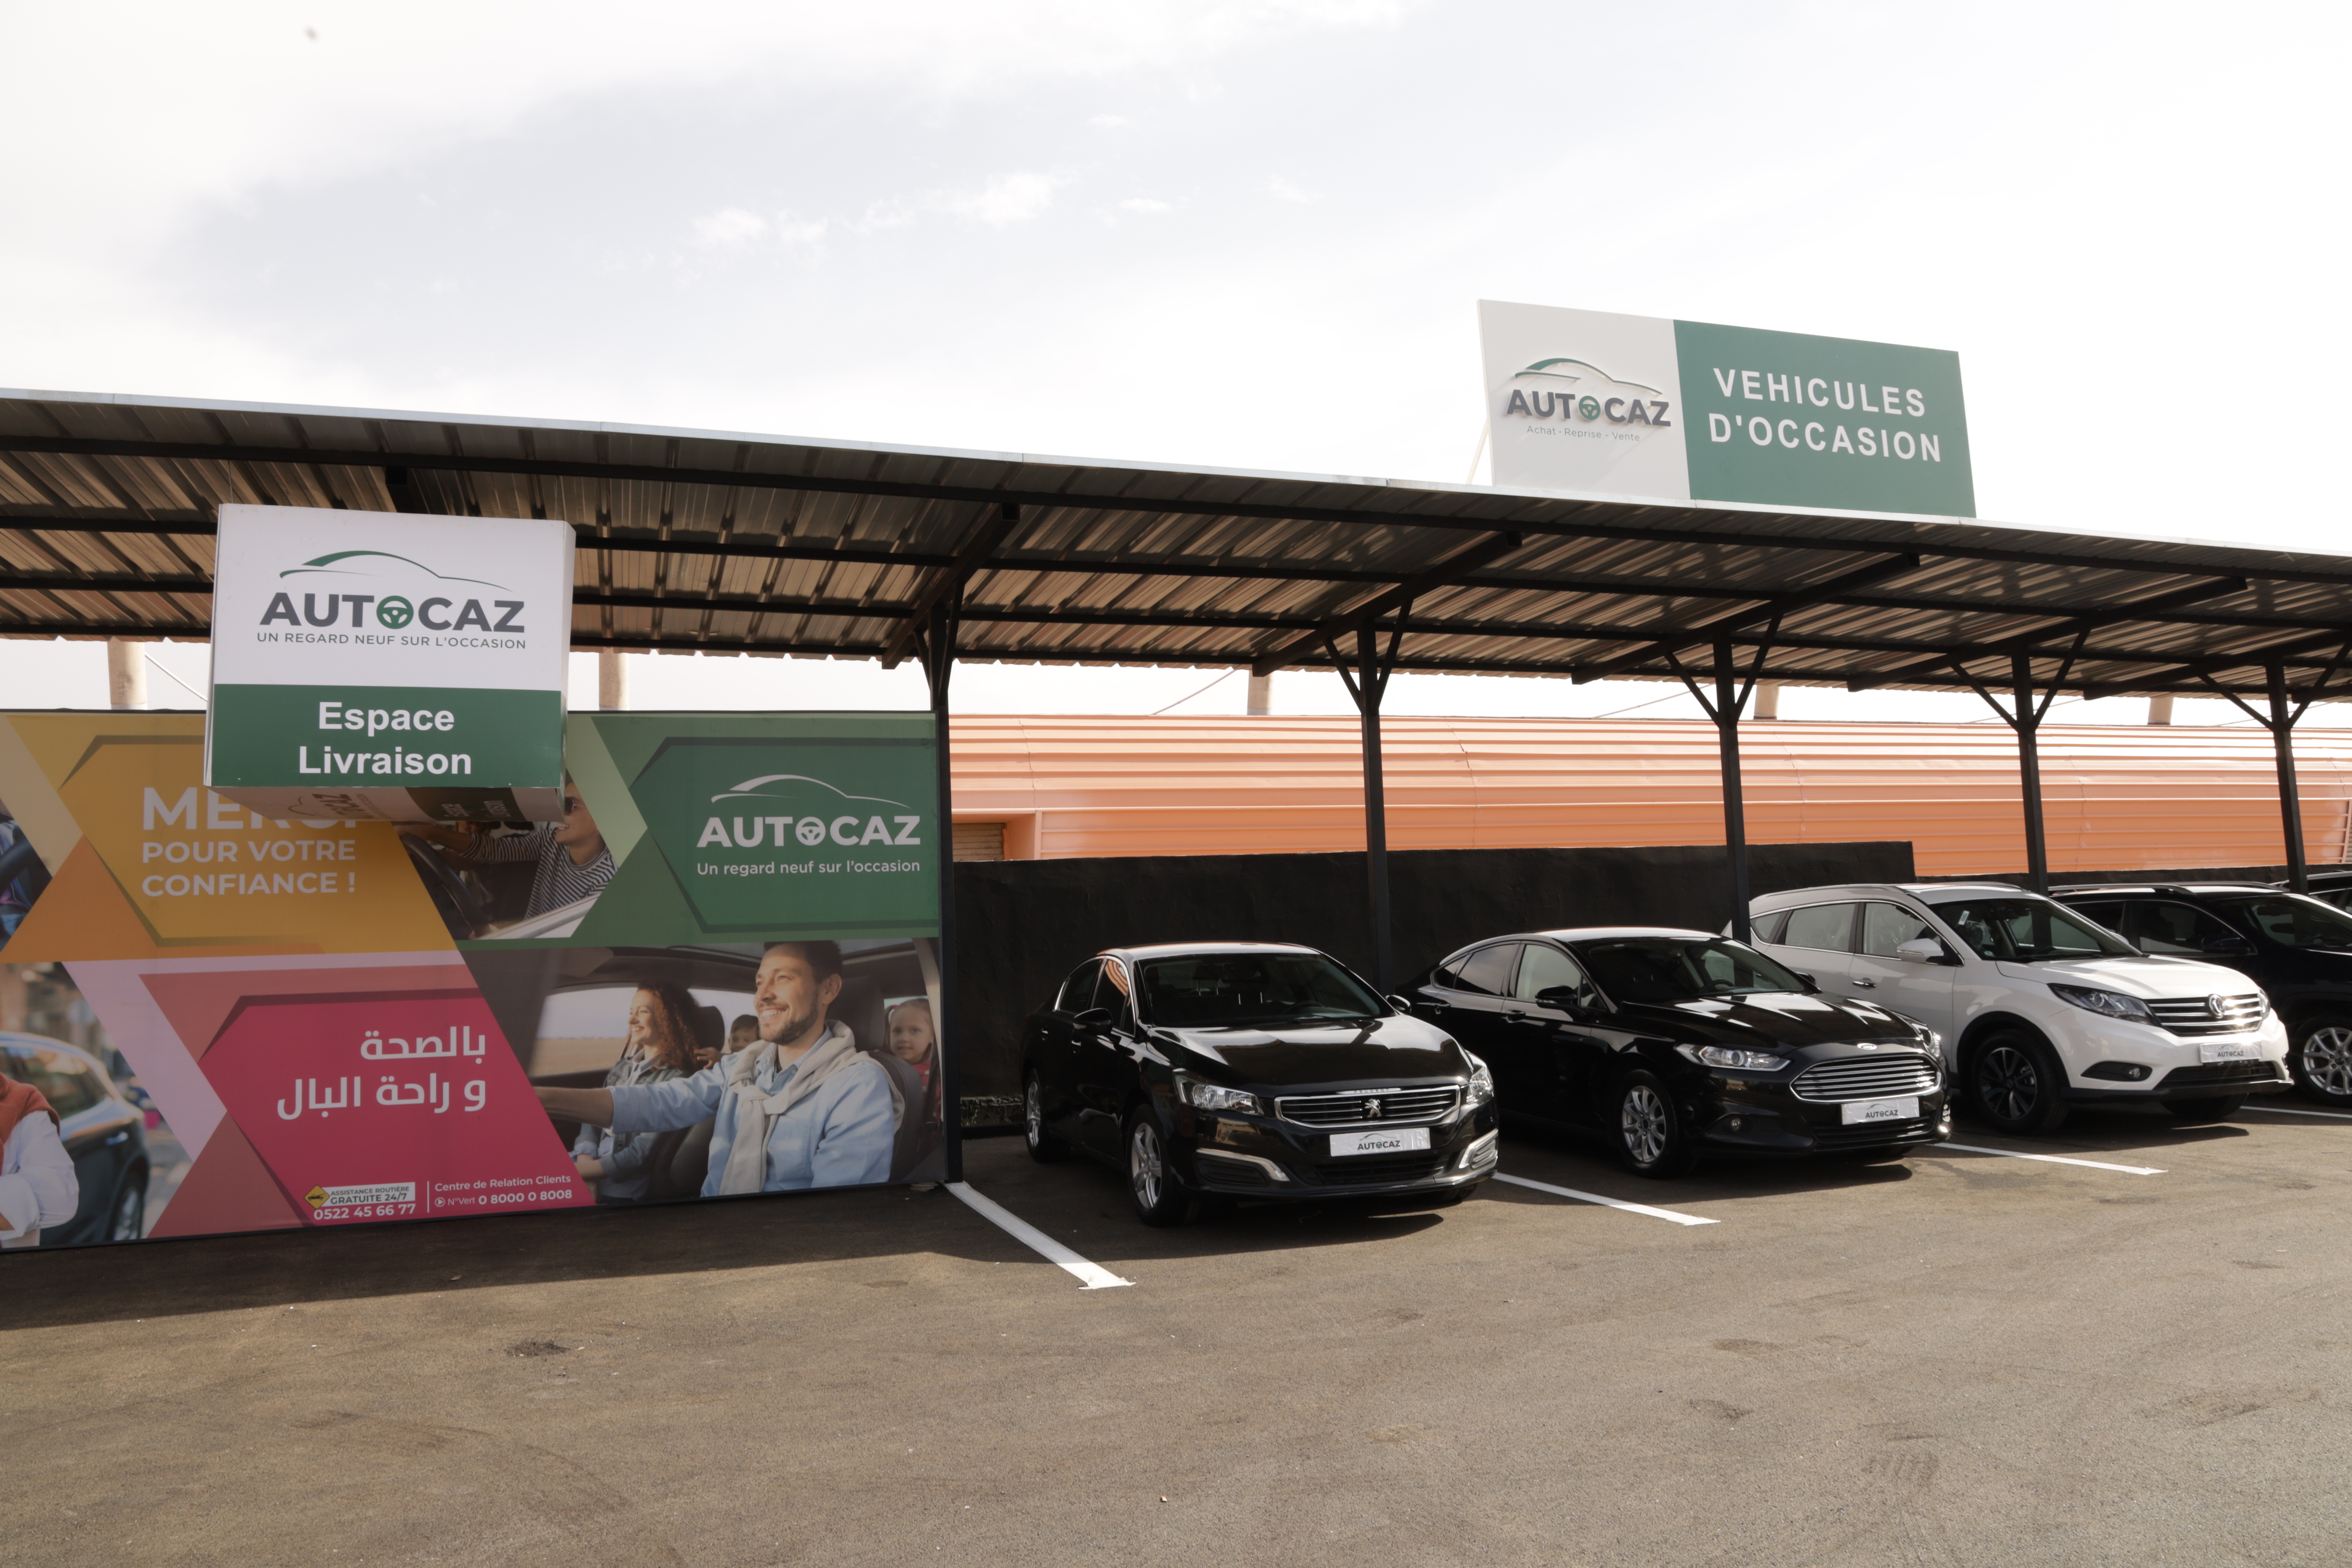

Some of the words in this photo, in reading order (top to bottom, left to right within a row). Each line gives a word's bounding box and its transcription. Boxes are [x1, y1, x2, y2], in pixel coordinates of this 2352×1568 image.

[1713, 368, 1925, 417] VEHICULES
[1506, 389, 1671, 427] AUTOCAZ
[1527, 426, 1556, 435] Achat
[1564, 428, 1602, 438] Reprise
[1612, 432, 1640, 441] Vente
[1709, 413, 1941, 462] D'OCCASION
[259, 592, 525, 633] AUTOCAZ
[257, 632, 279, 643] UN
[285, 633, 349, 644] REGARD
[355, 634, 395, 645] NEUF
[401, 635, 430, 646] SUR
[436, 637, 526, 649] L'OCCASION
[319, 701, 455, 737] Espace
[299, 746, 471, 775] Livraison
[696, 815, 921, 848] AUTOCAZ
[142, 841, 238, 864] POUR
[247, 840, 356, 862] VOTRE
[697, 863, 718, 875] Un
[724, 861, 775, 877] regard
[780, 861, 814, 873] neuf
[819, 861, 842, 873] sur
[847, 859, 920, 873] l'occasion
[142, 872, 338, 897] CONFIANCE
[360, 1026, 485, 1064] بالصحة
[277, 1076, 361, 1120] البال
[376, 1073, 449, 1114] راحة
[464, 1080, 486, 1112] و
[1865, 1110, 1898, 1118] AUTOCAZ
[1357, 1140, 1401, 1150] AUTOCAZ
[435, 1182, 472, 1192] Centre
[473, 1180, 487, 1190] de
[490, 1177, 533, 1188] Relation
[536, 1174, 571, 1185] Clients
[331, 1194, 382, 1204] GRATUITE
[384, 1192, 407, 1201] 24/7
[447, 1196, 475, 1206] N°Vert
[478, 1195, 487, 1205] 0
[490, 1193, 525, 1205] 8000
[528, 1192, 537, 1202] 0
[540, 1189, 572, 1201] 8008
[314, 1207, 349, 1220] 0522
[354, 1206, 372, 1217] 45
[376, 1205, 394, 1216] 66
[398, 1204, 416, 1214] 77
